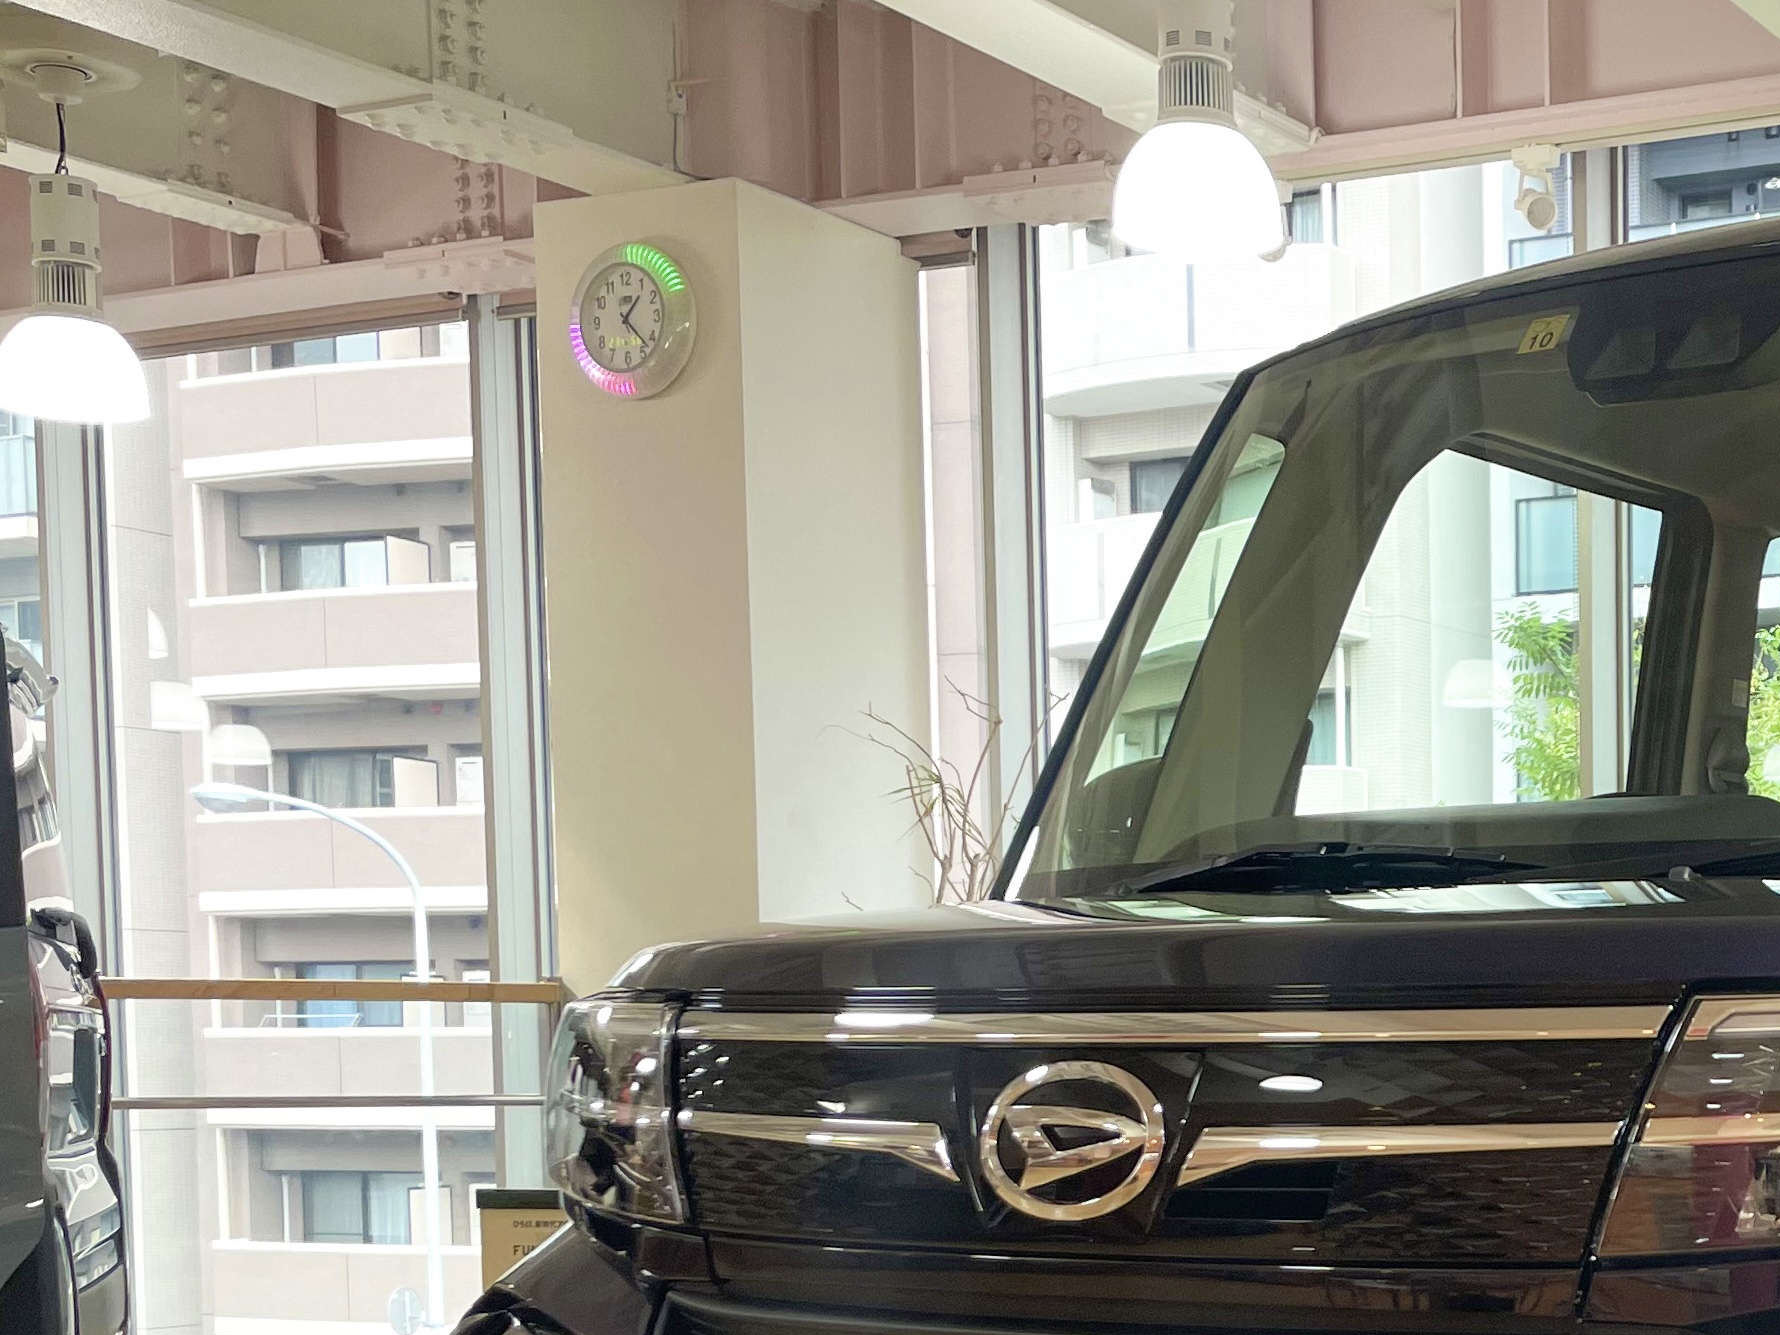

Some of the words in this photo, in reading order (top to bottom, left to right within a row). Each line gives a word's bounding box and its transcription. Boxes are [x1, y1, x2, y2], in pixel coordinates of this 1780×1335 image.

[620, 272, 632, 286] 12
[639, 278, 644, 290] 1
[605, 280, 615, 294] 11
[596, 296, 606, 310] 10
[650, 290, 657, 304] 2
[653, 309, 660, 323] 3
[593, 317, 600, 330] 9
[599, 335, 605, 349] 8
[649, 330, 656, 342] 4
[1529, 331, 1554, 350] 10
[609, 348, 616, 362] 7
[625, 351, 632, 366] 6
[640, 346, 647, 359] 5
